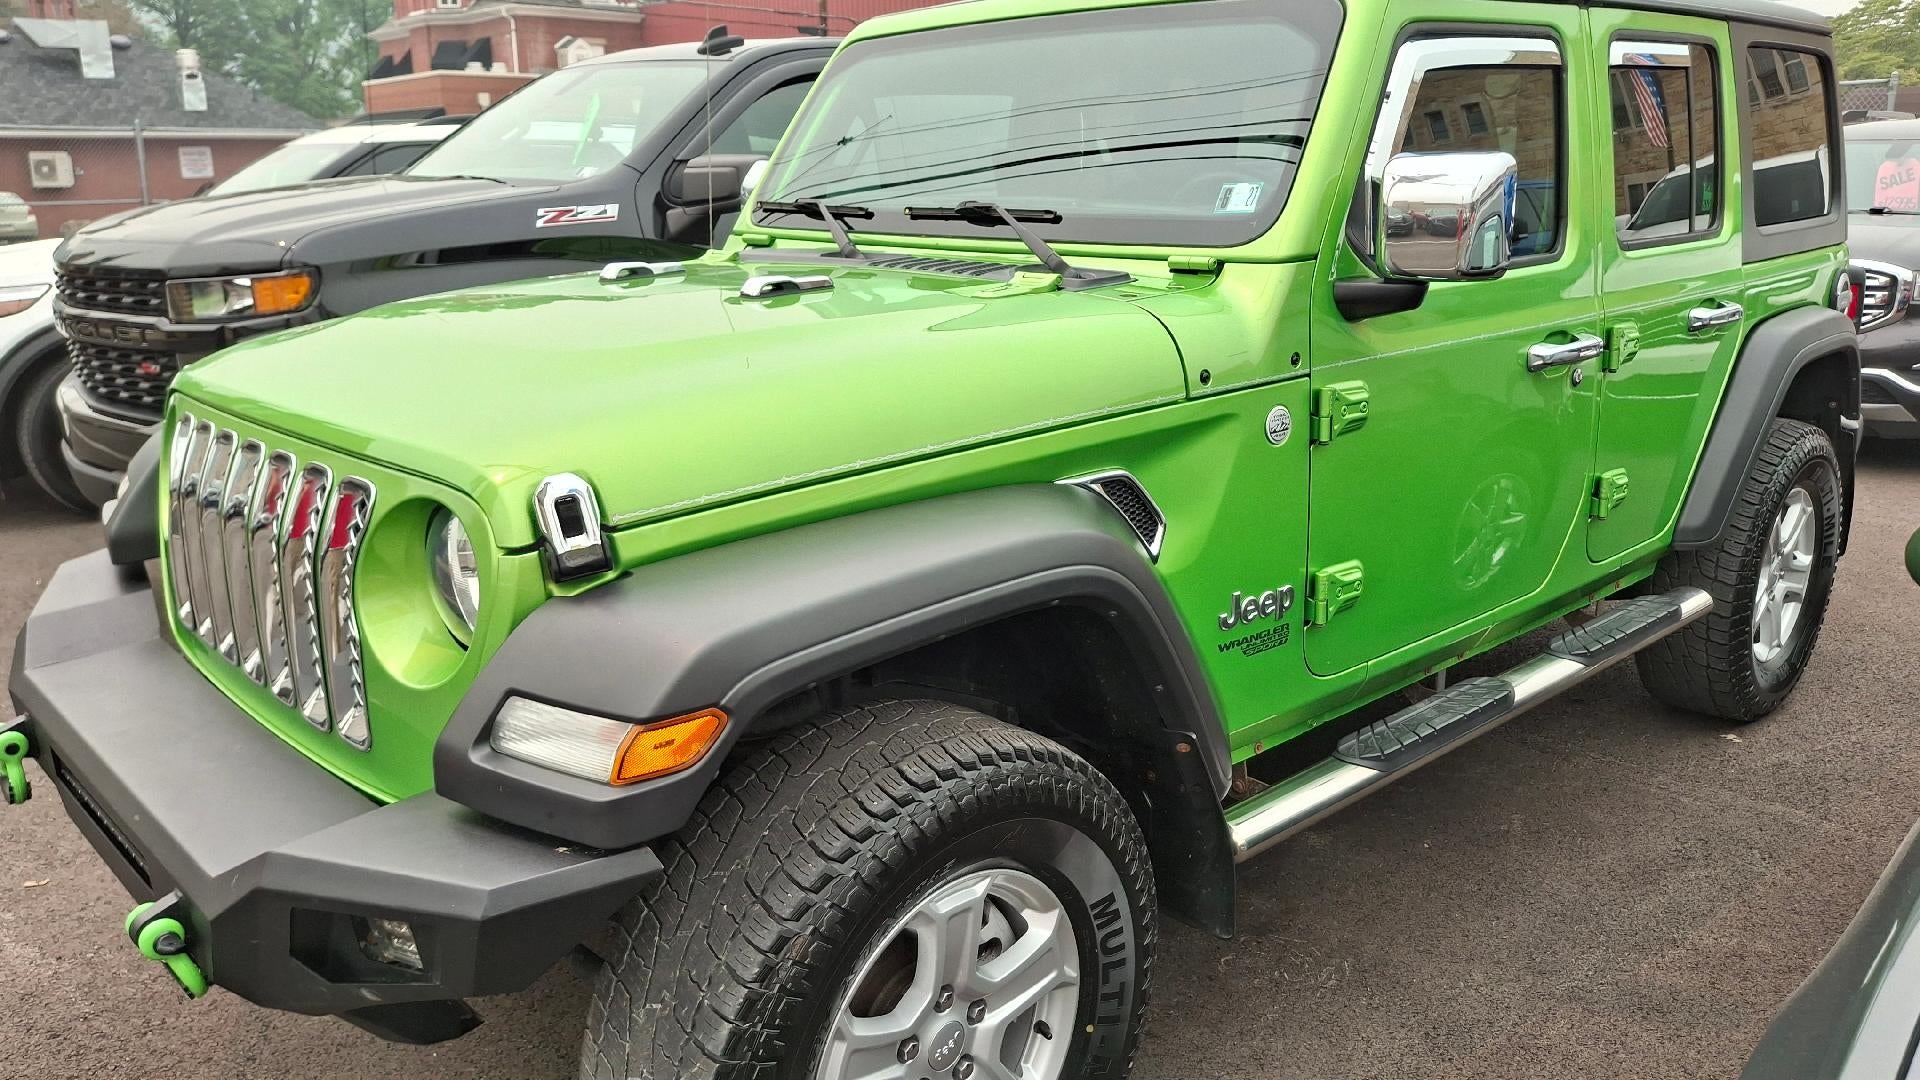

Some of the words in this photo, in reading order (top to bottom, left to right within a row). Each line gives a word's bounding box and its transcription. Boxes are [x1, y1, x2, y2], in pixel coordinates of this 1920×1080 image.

[1879, 167, 1915, 190] SALE
[535, 203, 620, 229] Z71
[1218, 584, 1295, 631] Jeep
[1217, 622, 1290, 653] WRANGLER
